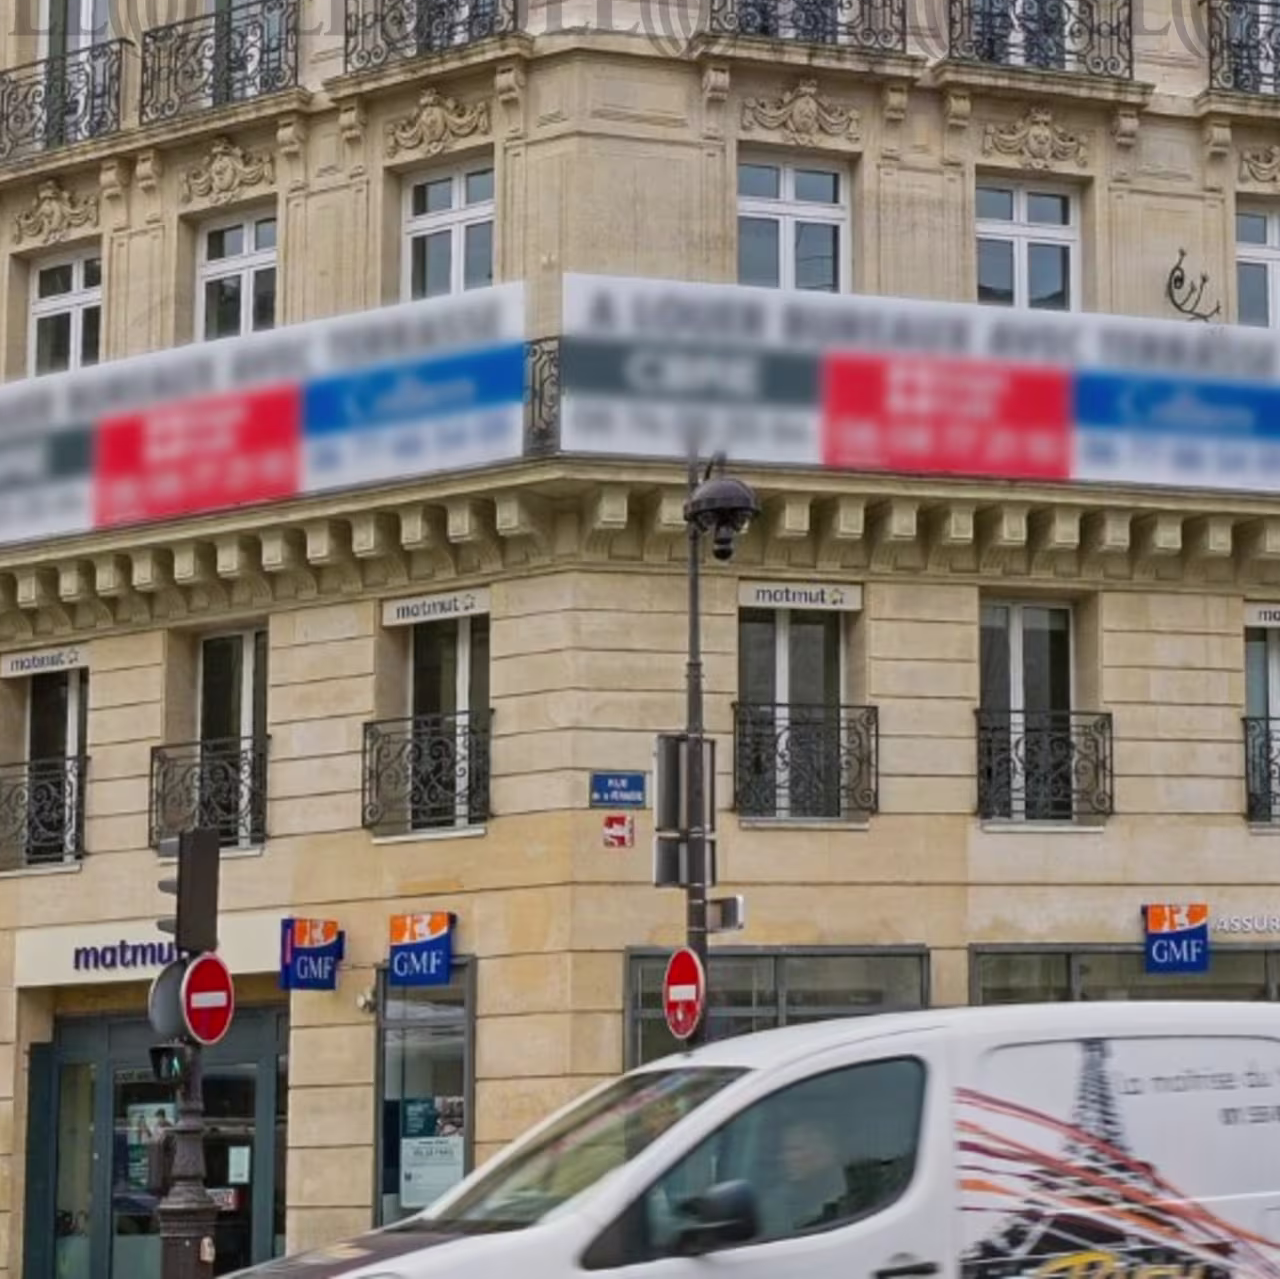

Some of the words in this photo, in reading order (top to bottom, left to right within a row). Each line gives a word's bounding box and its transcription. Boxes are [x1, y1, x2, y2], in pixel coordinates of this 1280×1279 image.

[756, 586, 825, 604] matmut
[74, 940, 177, 971] matmu
[1151, 938, 1203, 963] GMF
[296, 955, 335, 979] GMF
[393, 950, 443, 977] GMF
